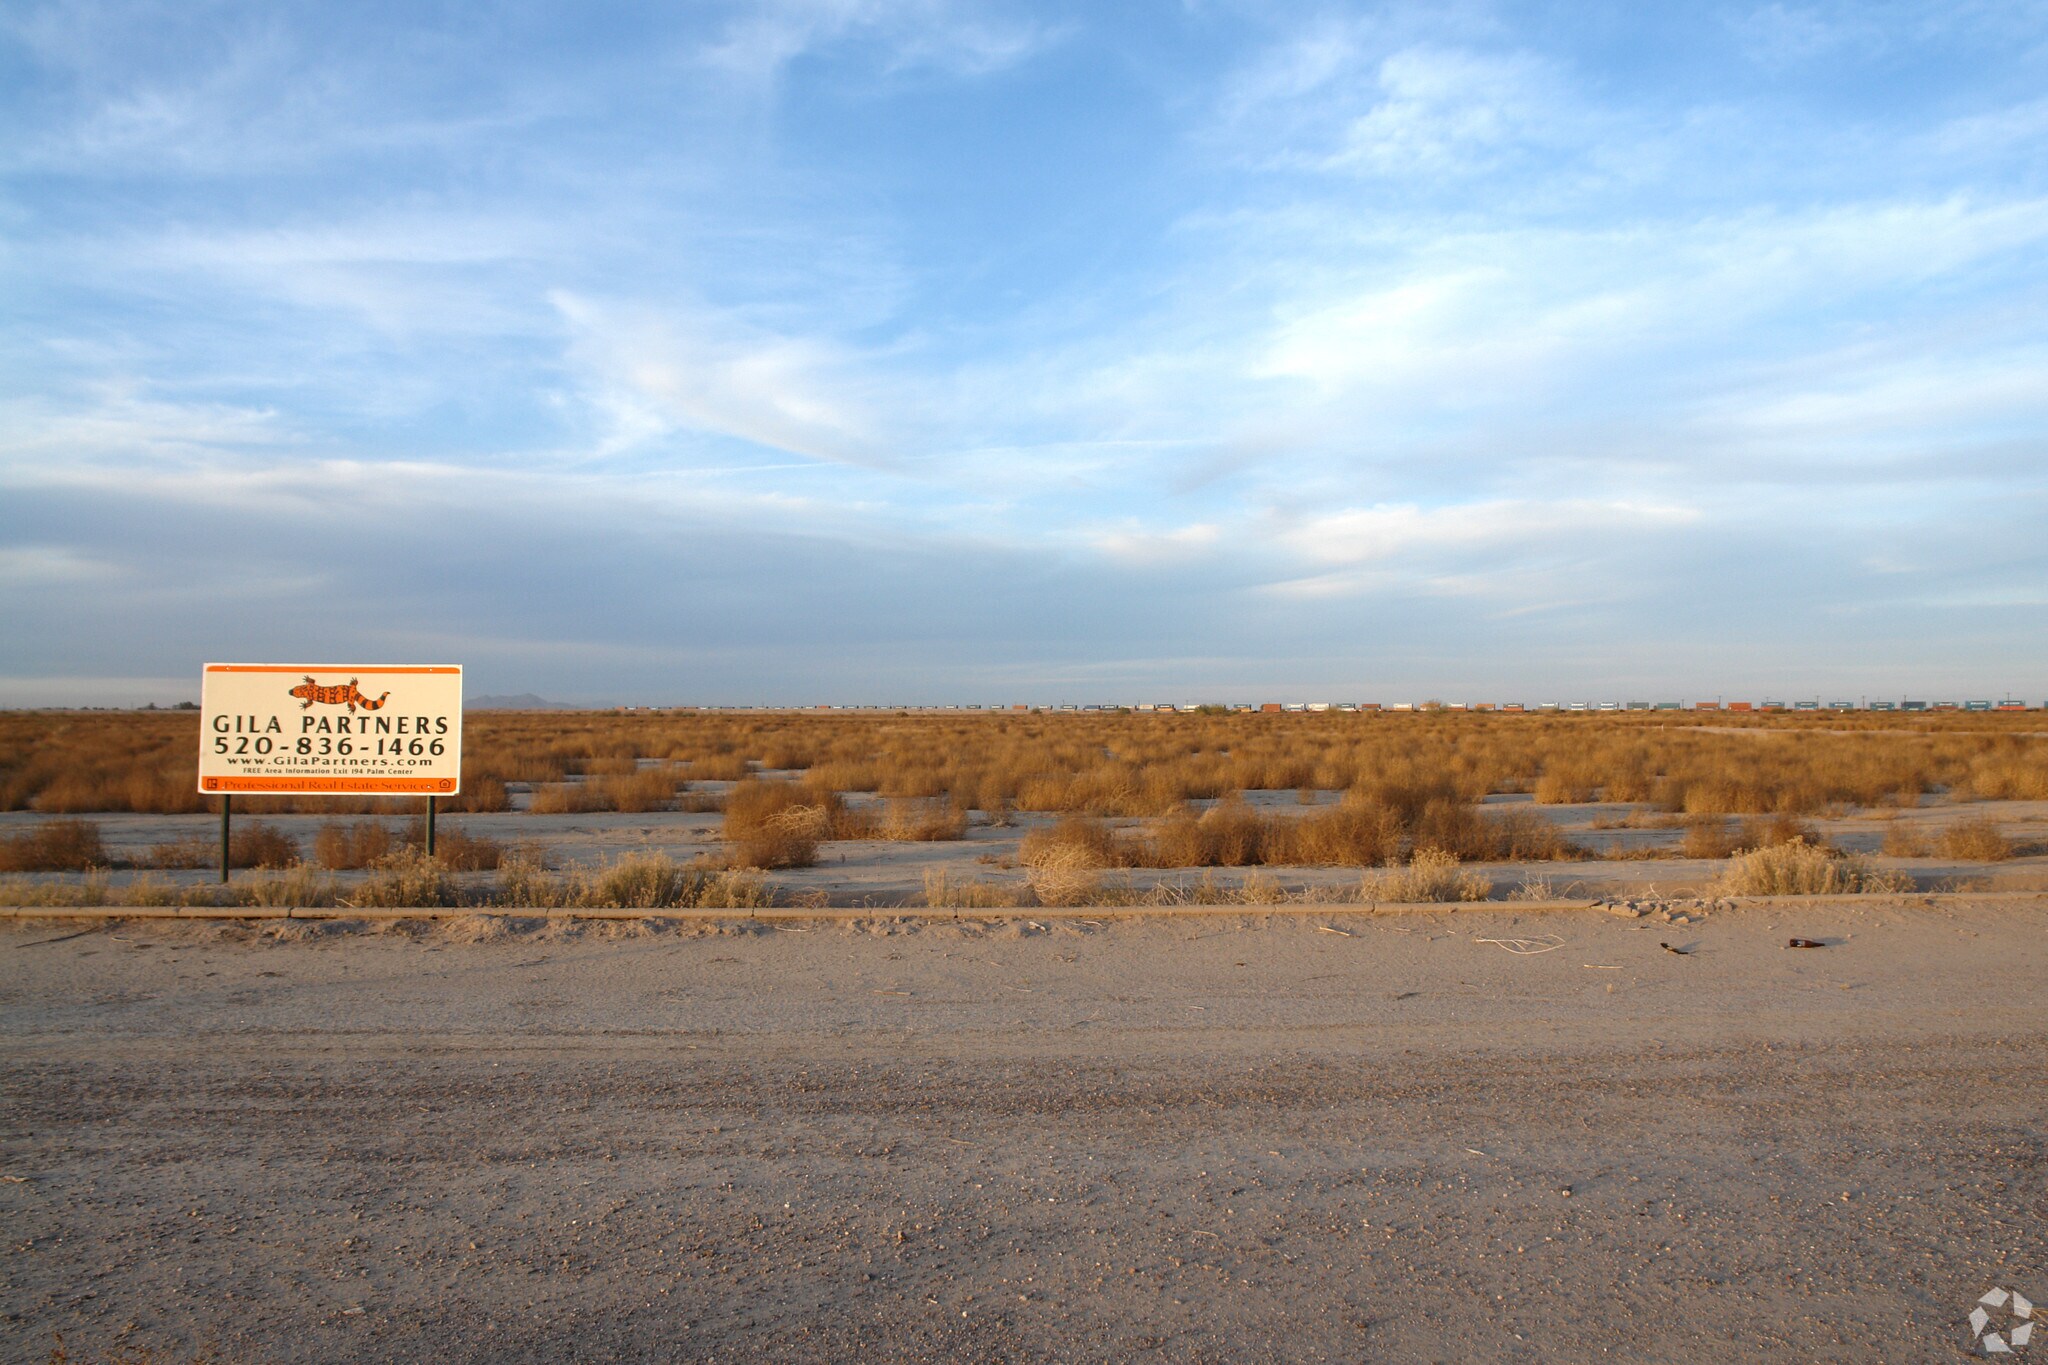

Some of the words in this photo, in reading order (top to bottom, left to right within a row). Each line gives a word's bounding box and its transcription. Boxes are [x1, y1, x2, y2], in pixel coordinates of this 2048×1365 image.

[212, 714, 282, 733] GILA
[301, 715, 448, 735] PARTNERS
[214, 736, 445, 756] 520-836-1466
[227, 756, 432, 766] www.GilaPartners.com
[285, 767, 330, 775] Information
[224, 780, 305, 790] Professional
[308, 780, 336, 790] Real
